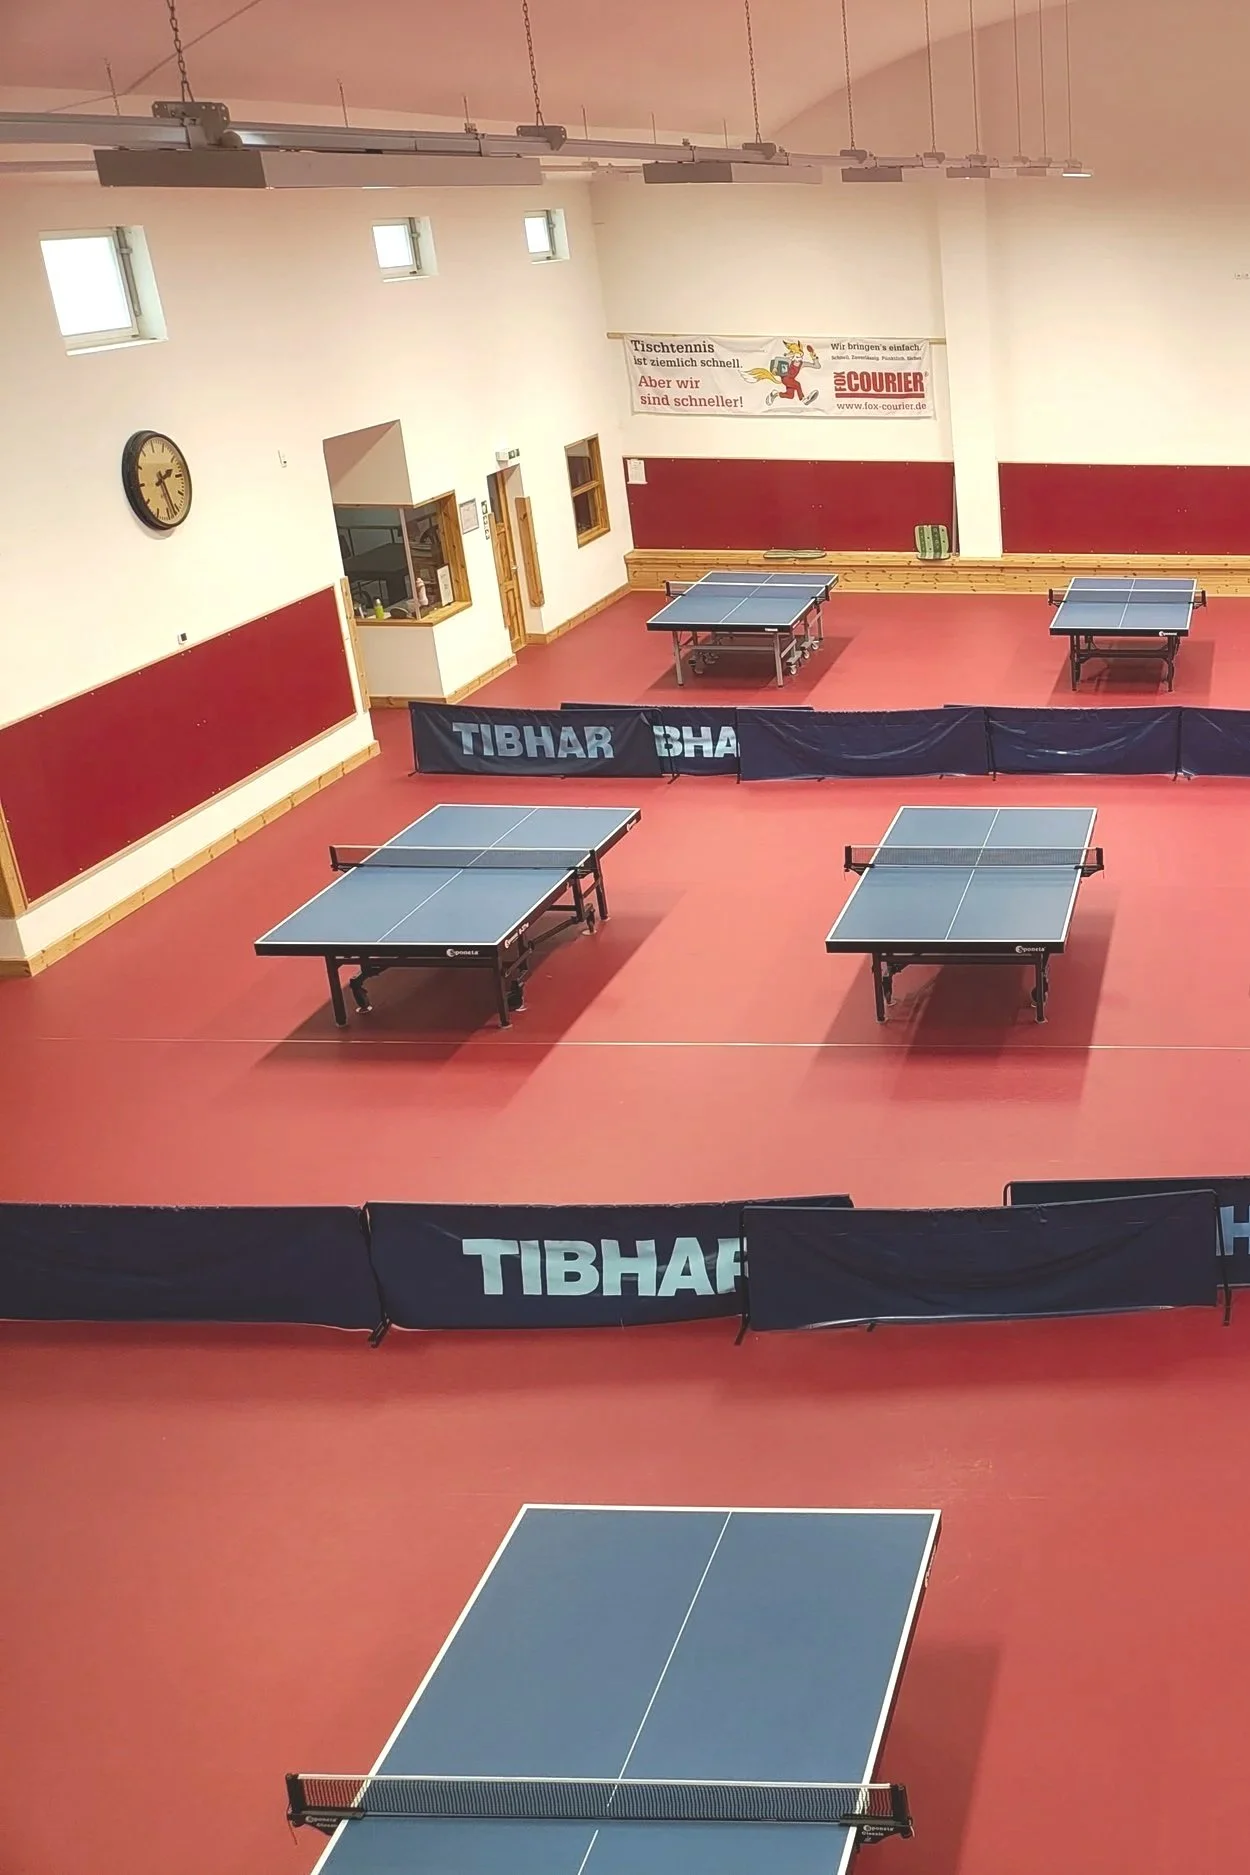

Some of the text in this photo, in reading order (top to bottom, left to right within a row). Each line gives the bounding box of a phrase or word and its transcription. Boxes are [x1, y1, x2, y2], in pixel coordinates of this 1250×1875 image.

[631, 340, 715, 353] Tischtennis
[831, 343, 846, 351] Wir
[633, 356, 743, 369] ist ziemlich schnell.
[638, 376, 700, 389] Aber wir
[834, 371, 925, 393] FOX COURIER
[640, 393, 744, 408] sind schneller!
[837, 402, 927, 411] www.fox-courier.de
[452, 721, 614, 759] TIBHAR
